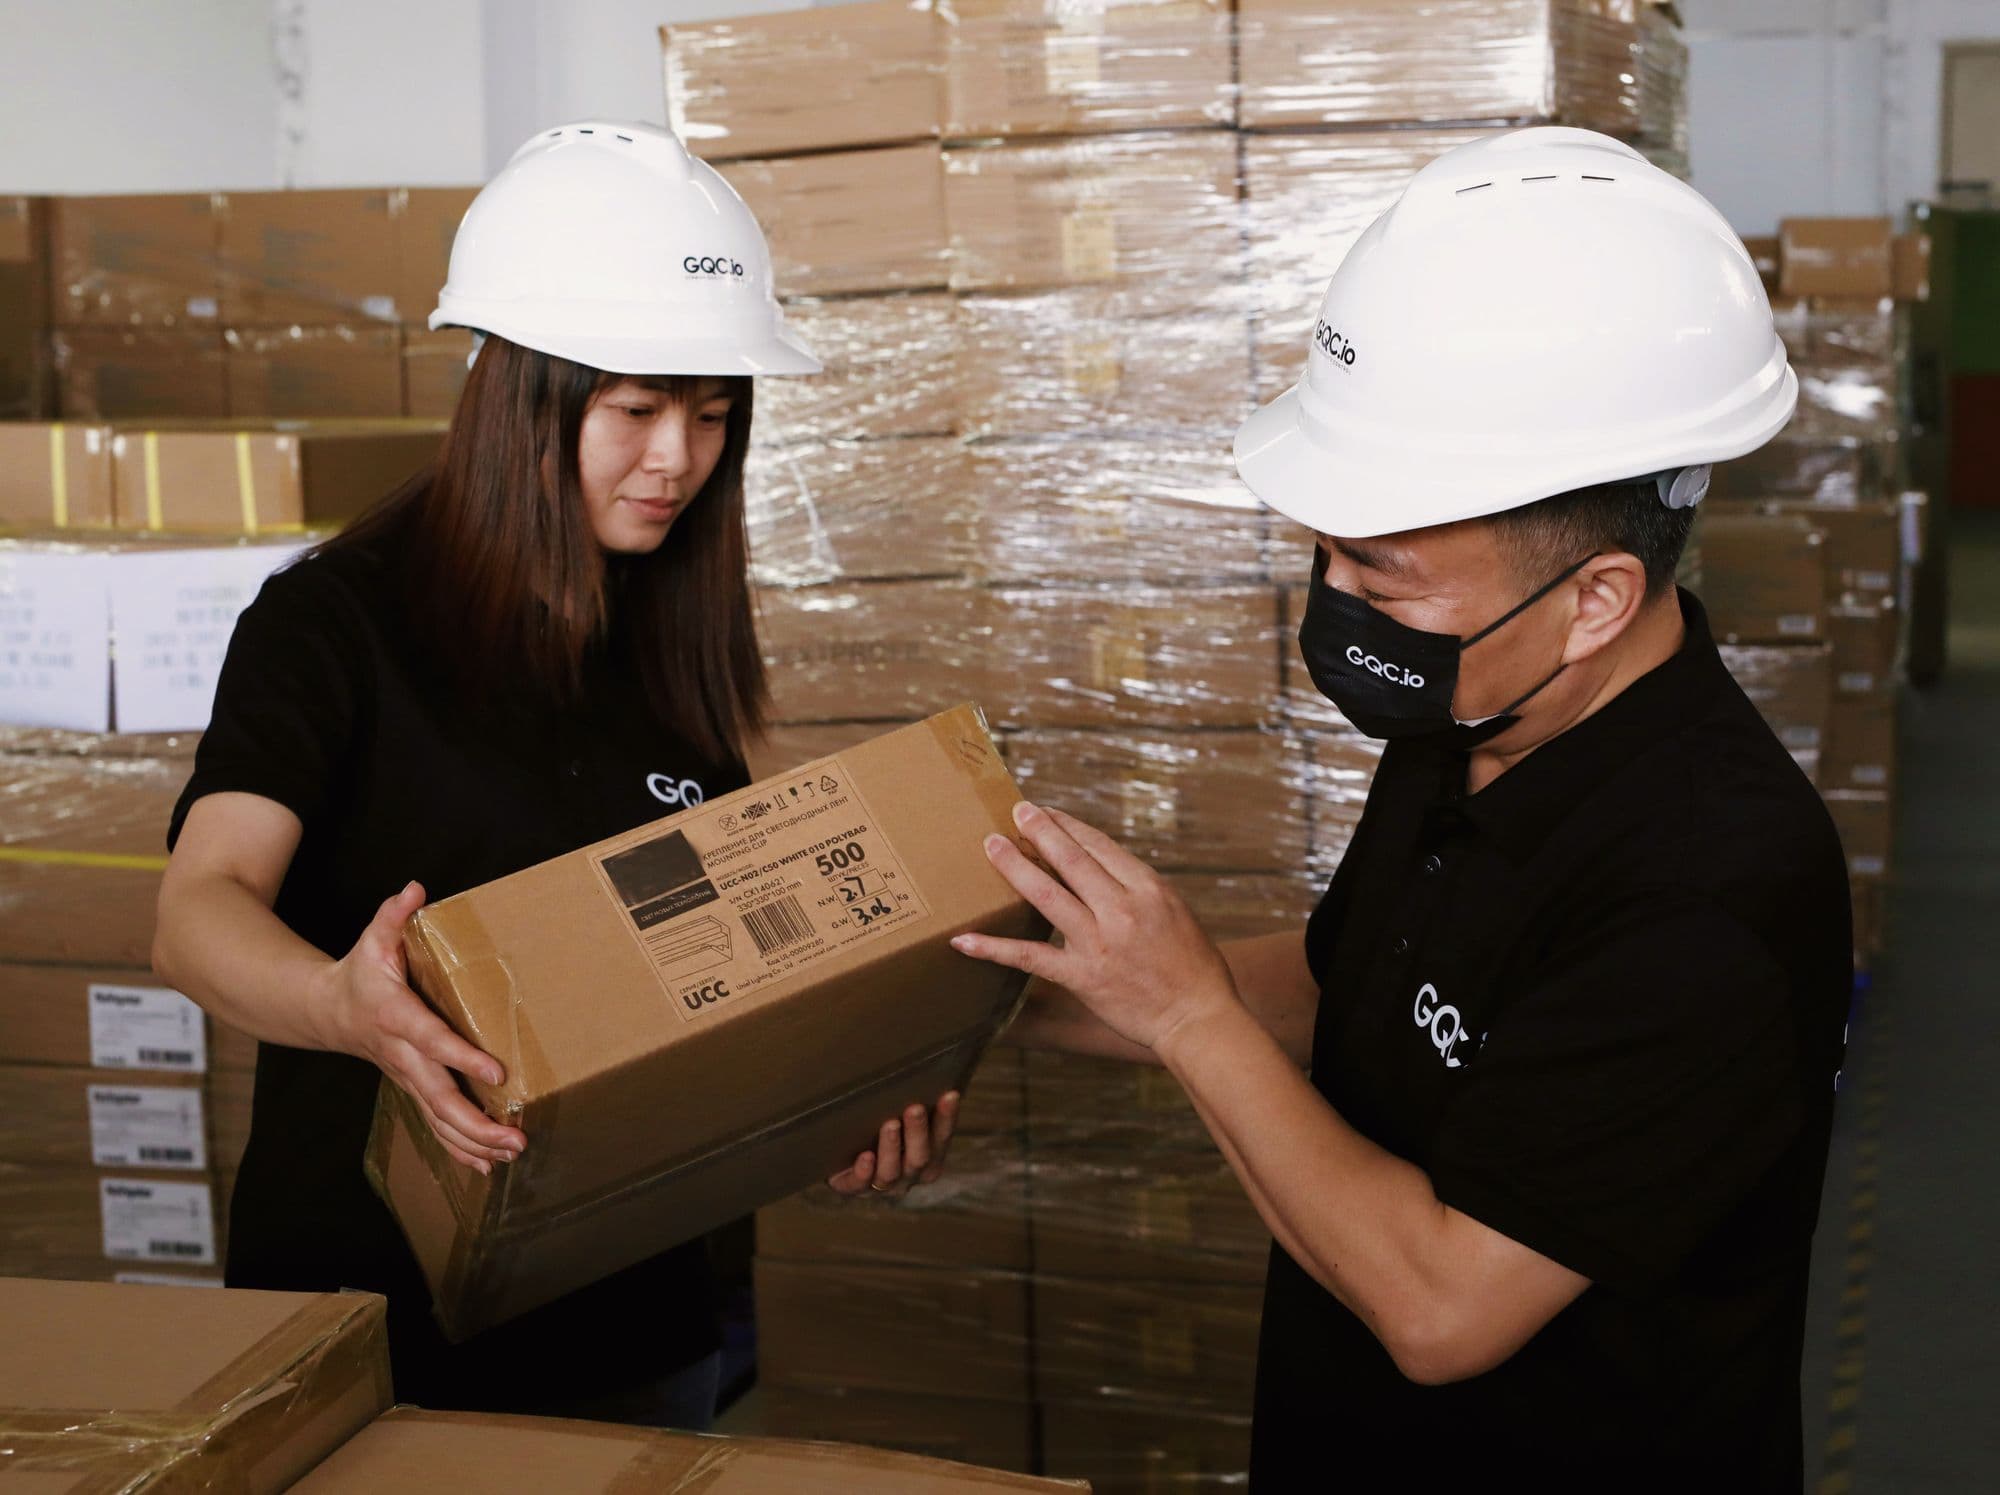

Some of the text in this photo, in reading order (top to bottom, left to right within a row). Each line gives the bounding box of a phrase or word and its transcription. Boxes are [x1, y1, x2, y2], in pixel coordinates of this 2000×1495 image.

[683, 256, 744, 276] GQC.io
[1316, 319, 1356, 366] GQC.io
[1346, 645, 1425, 688] GQC.io
[703, 795, 848, 861] КРЕПЛЕНИЕ ДЛЯ СВЕТОДИОДНЫХ ЛЕНТ
[706, 846, 751, 868] MOUNTING
[718, 824, 867, 890] UCC-N02/C50 WHITE 010 POLYBAG
[815, 842, 866, 876] 500
[742, 875, 785, 898] CX140621
[785, 880, 802, 891] mm
[882, 871, 896, 879] Kg
[816, 894, 838, 907] N.W.
[839, 876, 866, 902] 2.7
[895, 893, 909, 901] Kg
[830, 916, 851, 929] G.W.
[683, 980, 730, 1010] UCC
